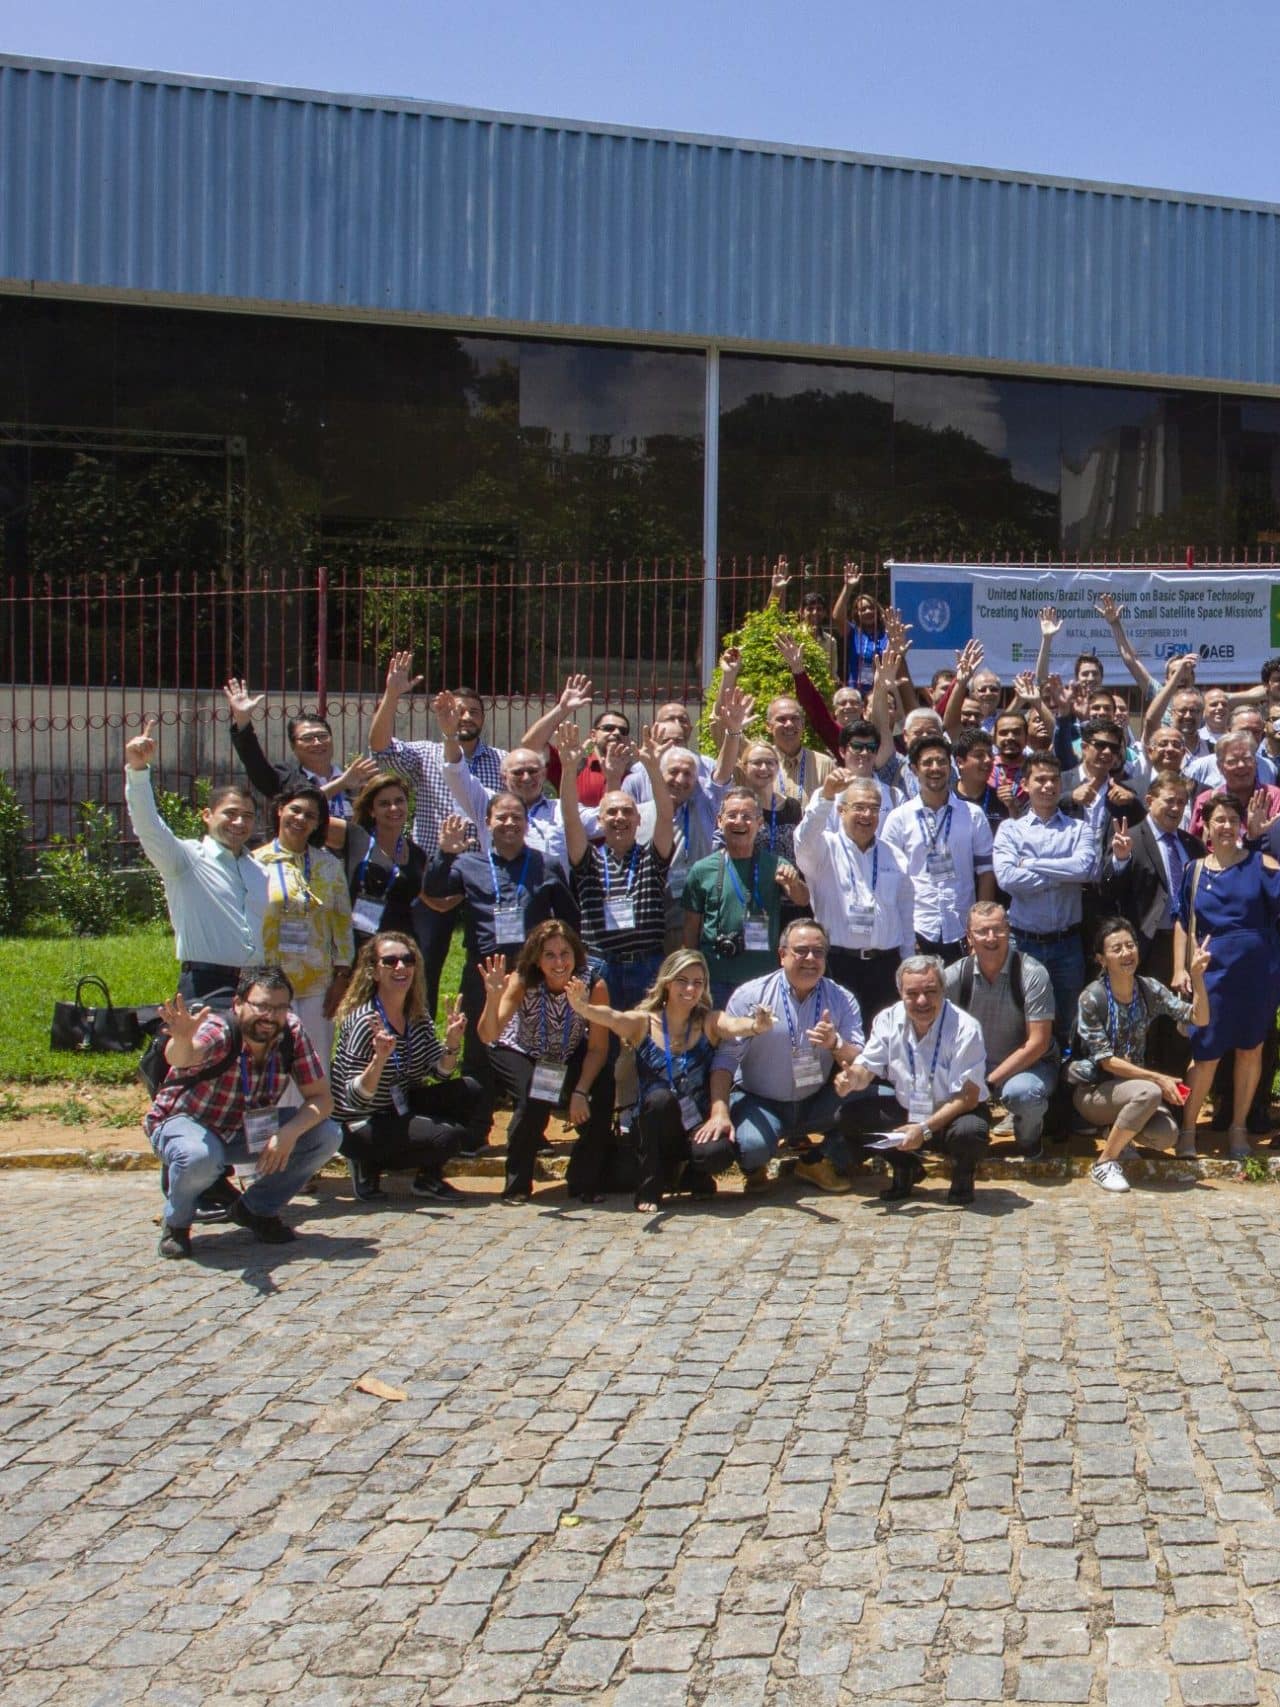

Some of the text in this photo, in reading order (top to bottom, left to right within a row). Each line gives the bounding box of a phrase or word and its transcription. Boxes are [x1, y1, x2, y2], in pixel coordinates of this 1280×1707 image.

[987, 587, 1018, 601] United
[1020, 587, 1085, 602] Nations/Brazil
[1140, 592, 1150, 602] on
[1153, 589, 1175, 602] Basic
[1178, 590, 1205, 604] Space
[1207, 588, 1256, 604] Technology
[1134, 605, 1158, 619] Small
[1160, 604, 1196, 619] Satellite
[1197, 605, 1222, 621] Space
